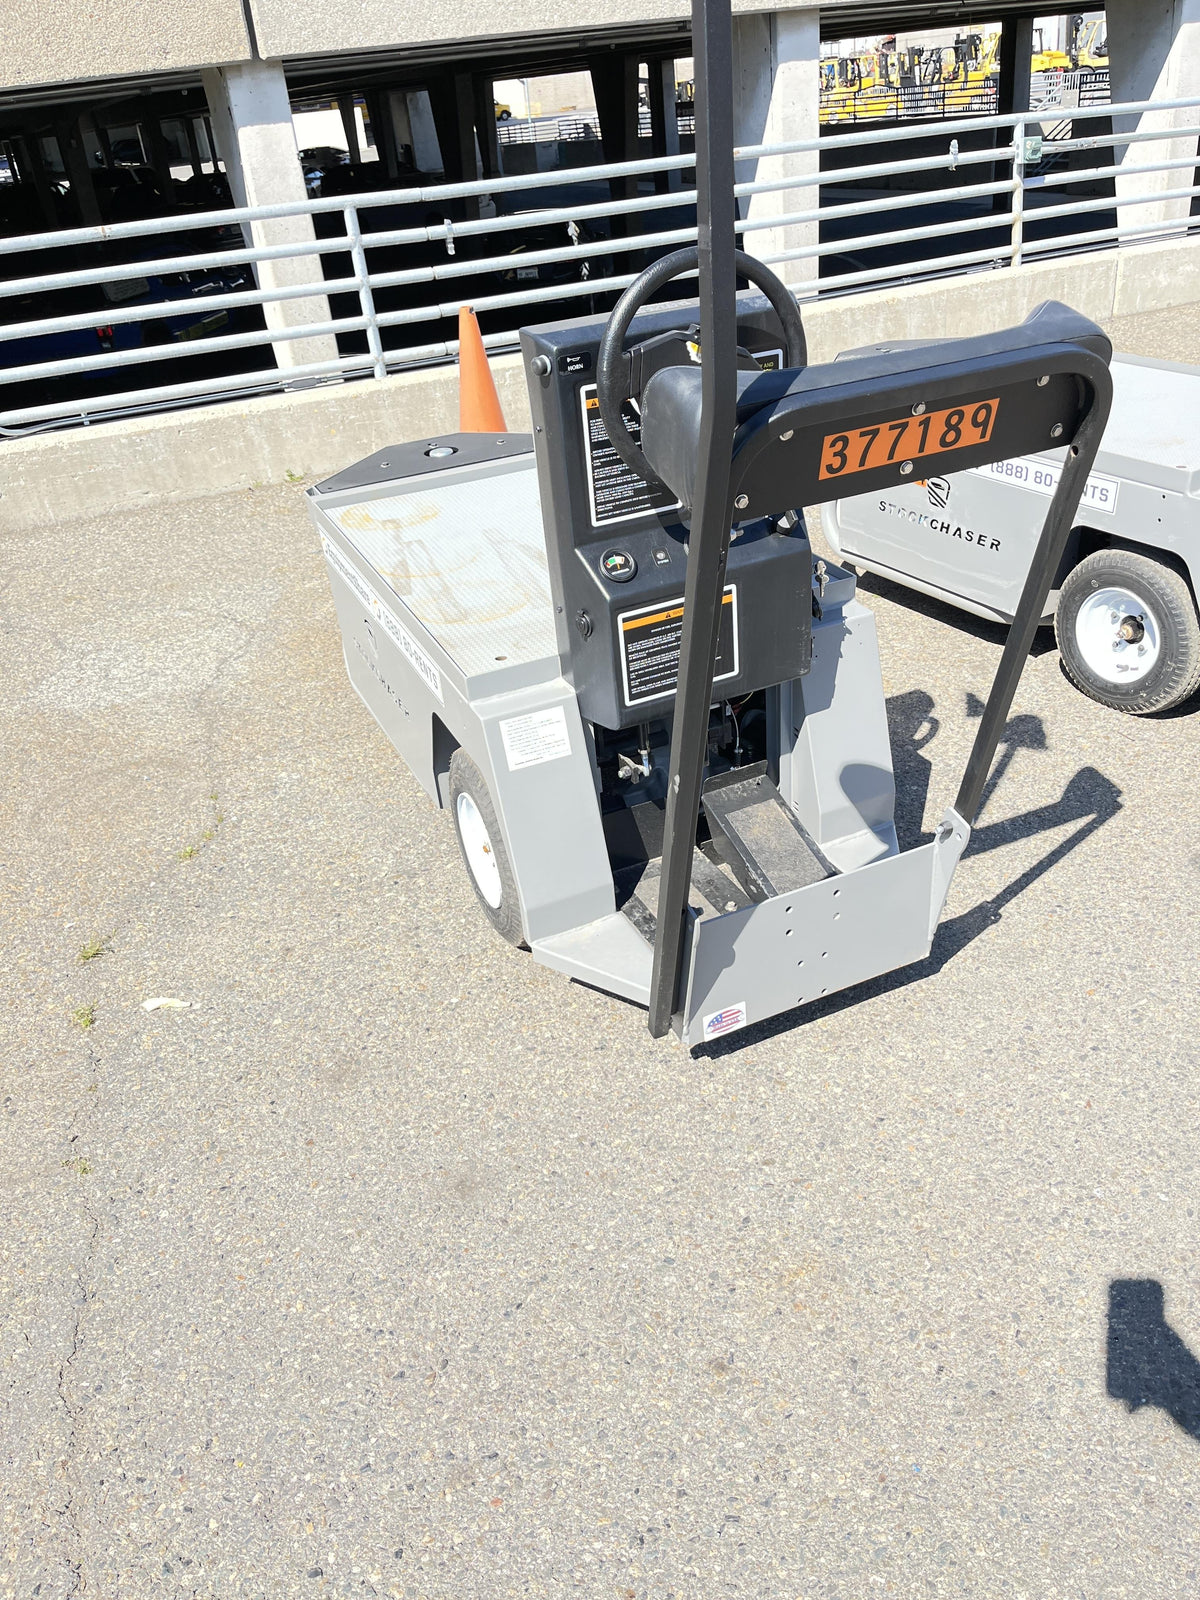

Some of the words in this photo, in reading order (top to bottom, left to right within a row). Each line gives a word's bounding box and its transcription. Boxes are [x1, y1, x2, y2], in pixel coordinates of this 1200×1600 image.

[568, 363, 583, 371] HORN
[825, 402, 992, 475] 377189
[879, 500, 1001, 551] STOCKCHASER
